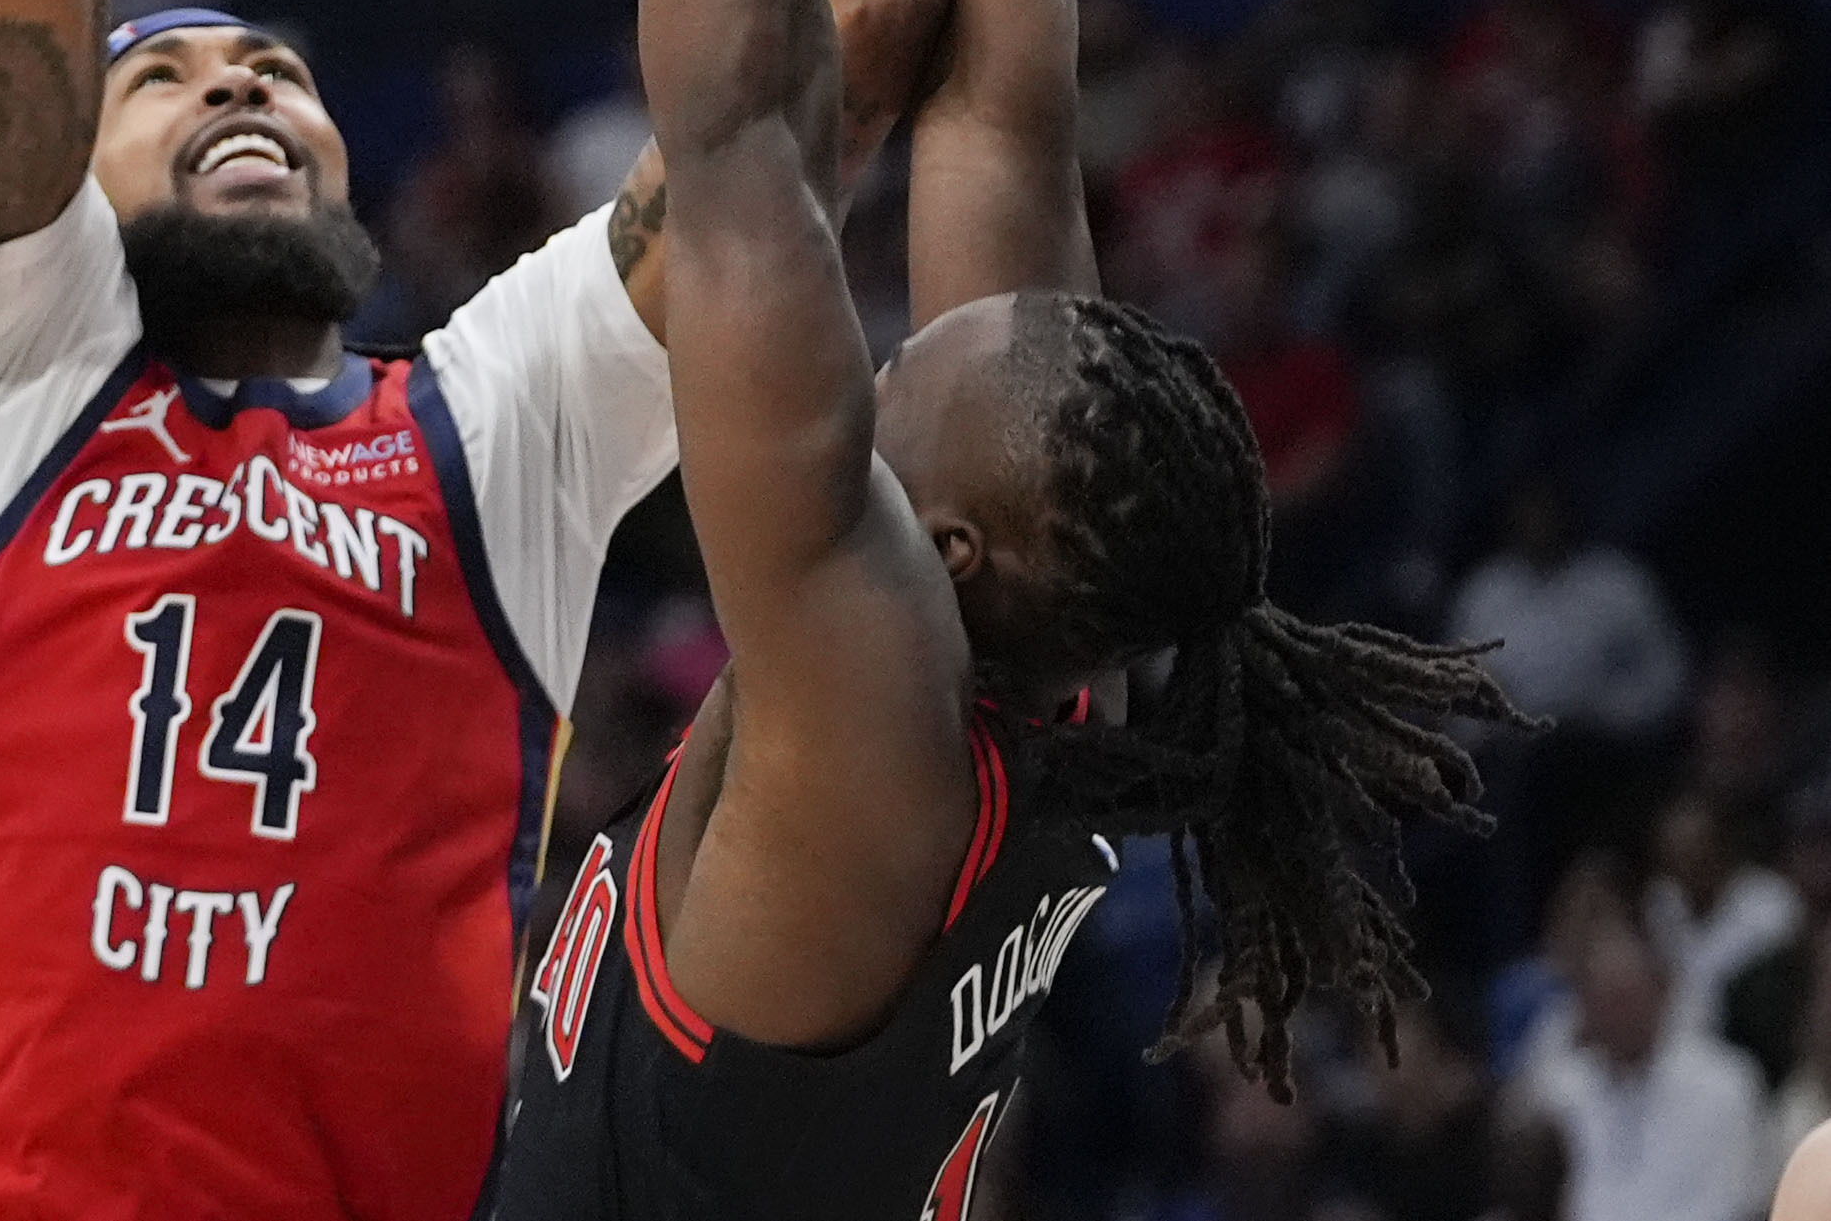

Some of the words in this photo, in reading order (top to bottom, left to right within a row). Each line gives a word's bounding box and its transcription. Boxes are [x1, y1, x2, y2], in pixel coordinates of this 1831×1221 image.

[42, 454, 428, 619] CRESCENT
[288, 456, 419, 487] PRODUCTS
[122, 593, 323, 842] 14
[91, 864, 296, 990] CITY
